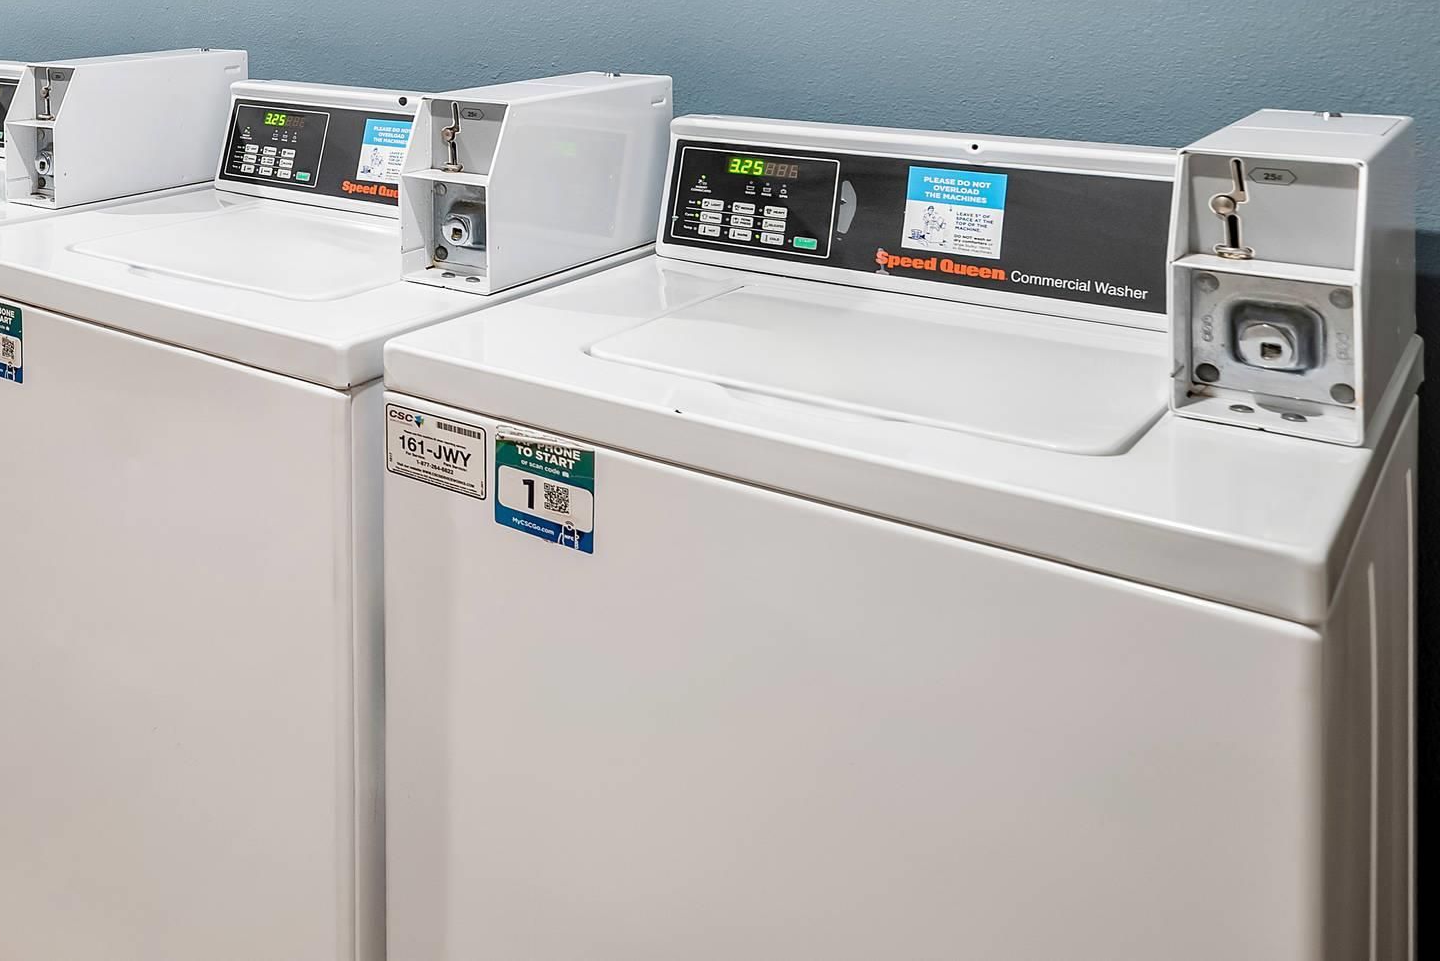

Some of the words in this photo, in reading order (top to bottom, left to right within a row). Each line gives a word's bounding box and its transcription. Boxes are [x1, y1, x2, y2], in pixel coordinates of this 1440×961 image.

[342, 180, 377, 194] Speed
[923, 176, 955, 186] PLEASE
[972, 181, 991, 189] NOT
[933, 185, 979, 195] OVERLOAD
[925, 191, 940, 199] THE
[942, 193, 987, 204] MACHINES
[875, 250, 937, 271] Speed
[940, 261, 1006, 281] Queen
[1010, 270, 1091, 292] Commercial
[1094, 281, 1148, 300] Washer
[389, 410, 413, 422] CSC
[399, 435, 471, 467] 161-JWY
[515, 445, 532, 457] TO
[535, 451, 575, 469] START
[537, 443, 581, 461] PHONE
[529, 461, 543, 470] scan
[544, 466, 560, 475] code
[522, 479, 535, 510] 1
[512, 517, 555, 536] MyCSCGo.com
